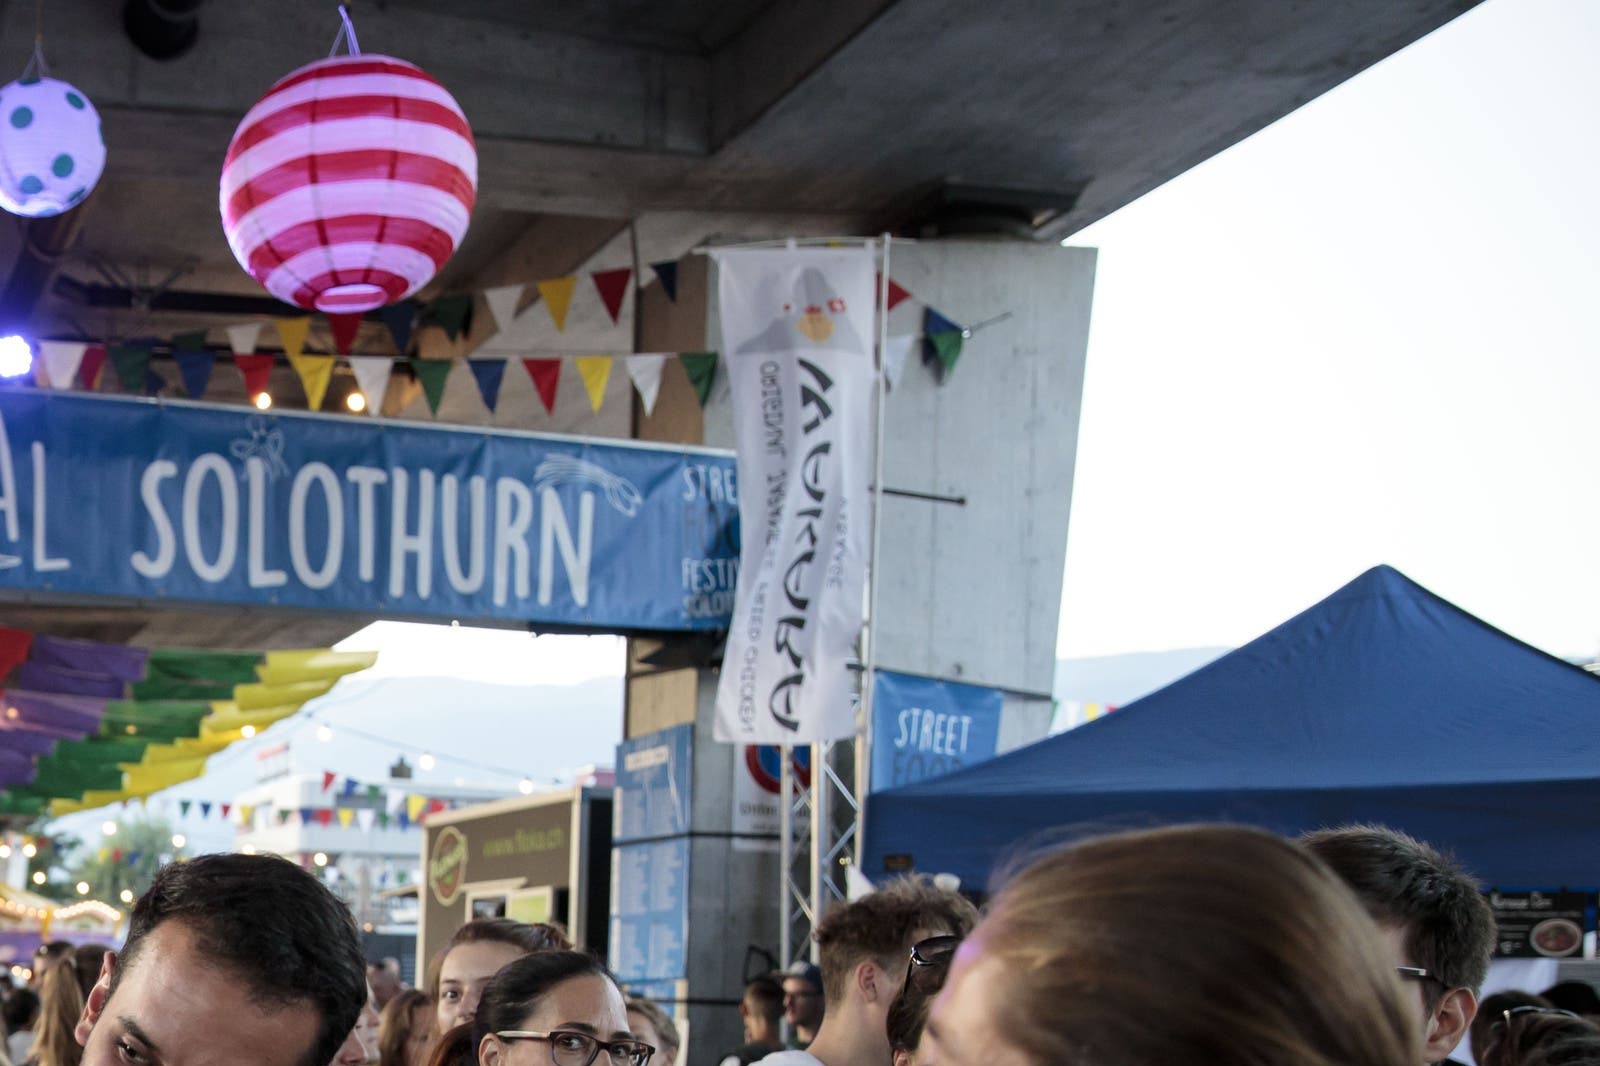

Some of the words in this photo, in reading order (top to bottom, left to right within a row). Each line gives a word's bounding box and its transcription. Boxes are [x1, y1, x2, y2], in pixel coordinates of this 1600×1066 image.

[682, 463, 738, 505] STRE
[130, 452, 595, 607] SOLOTHURN
[893, 707, 973, 756] STREET
